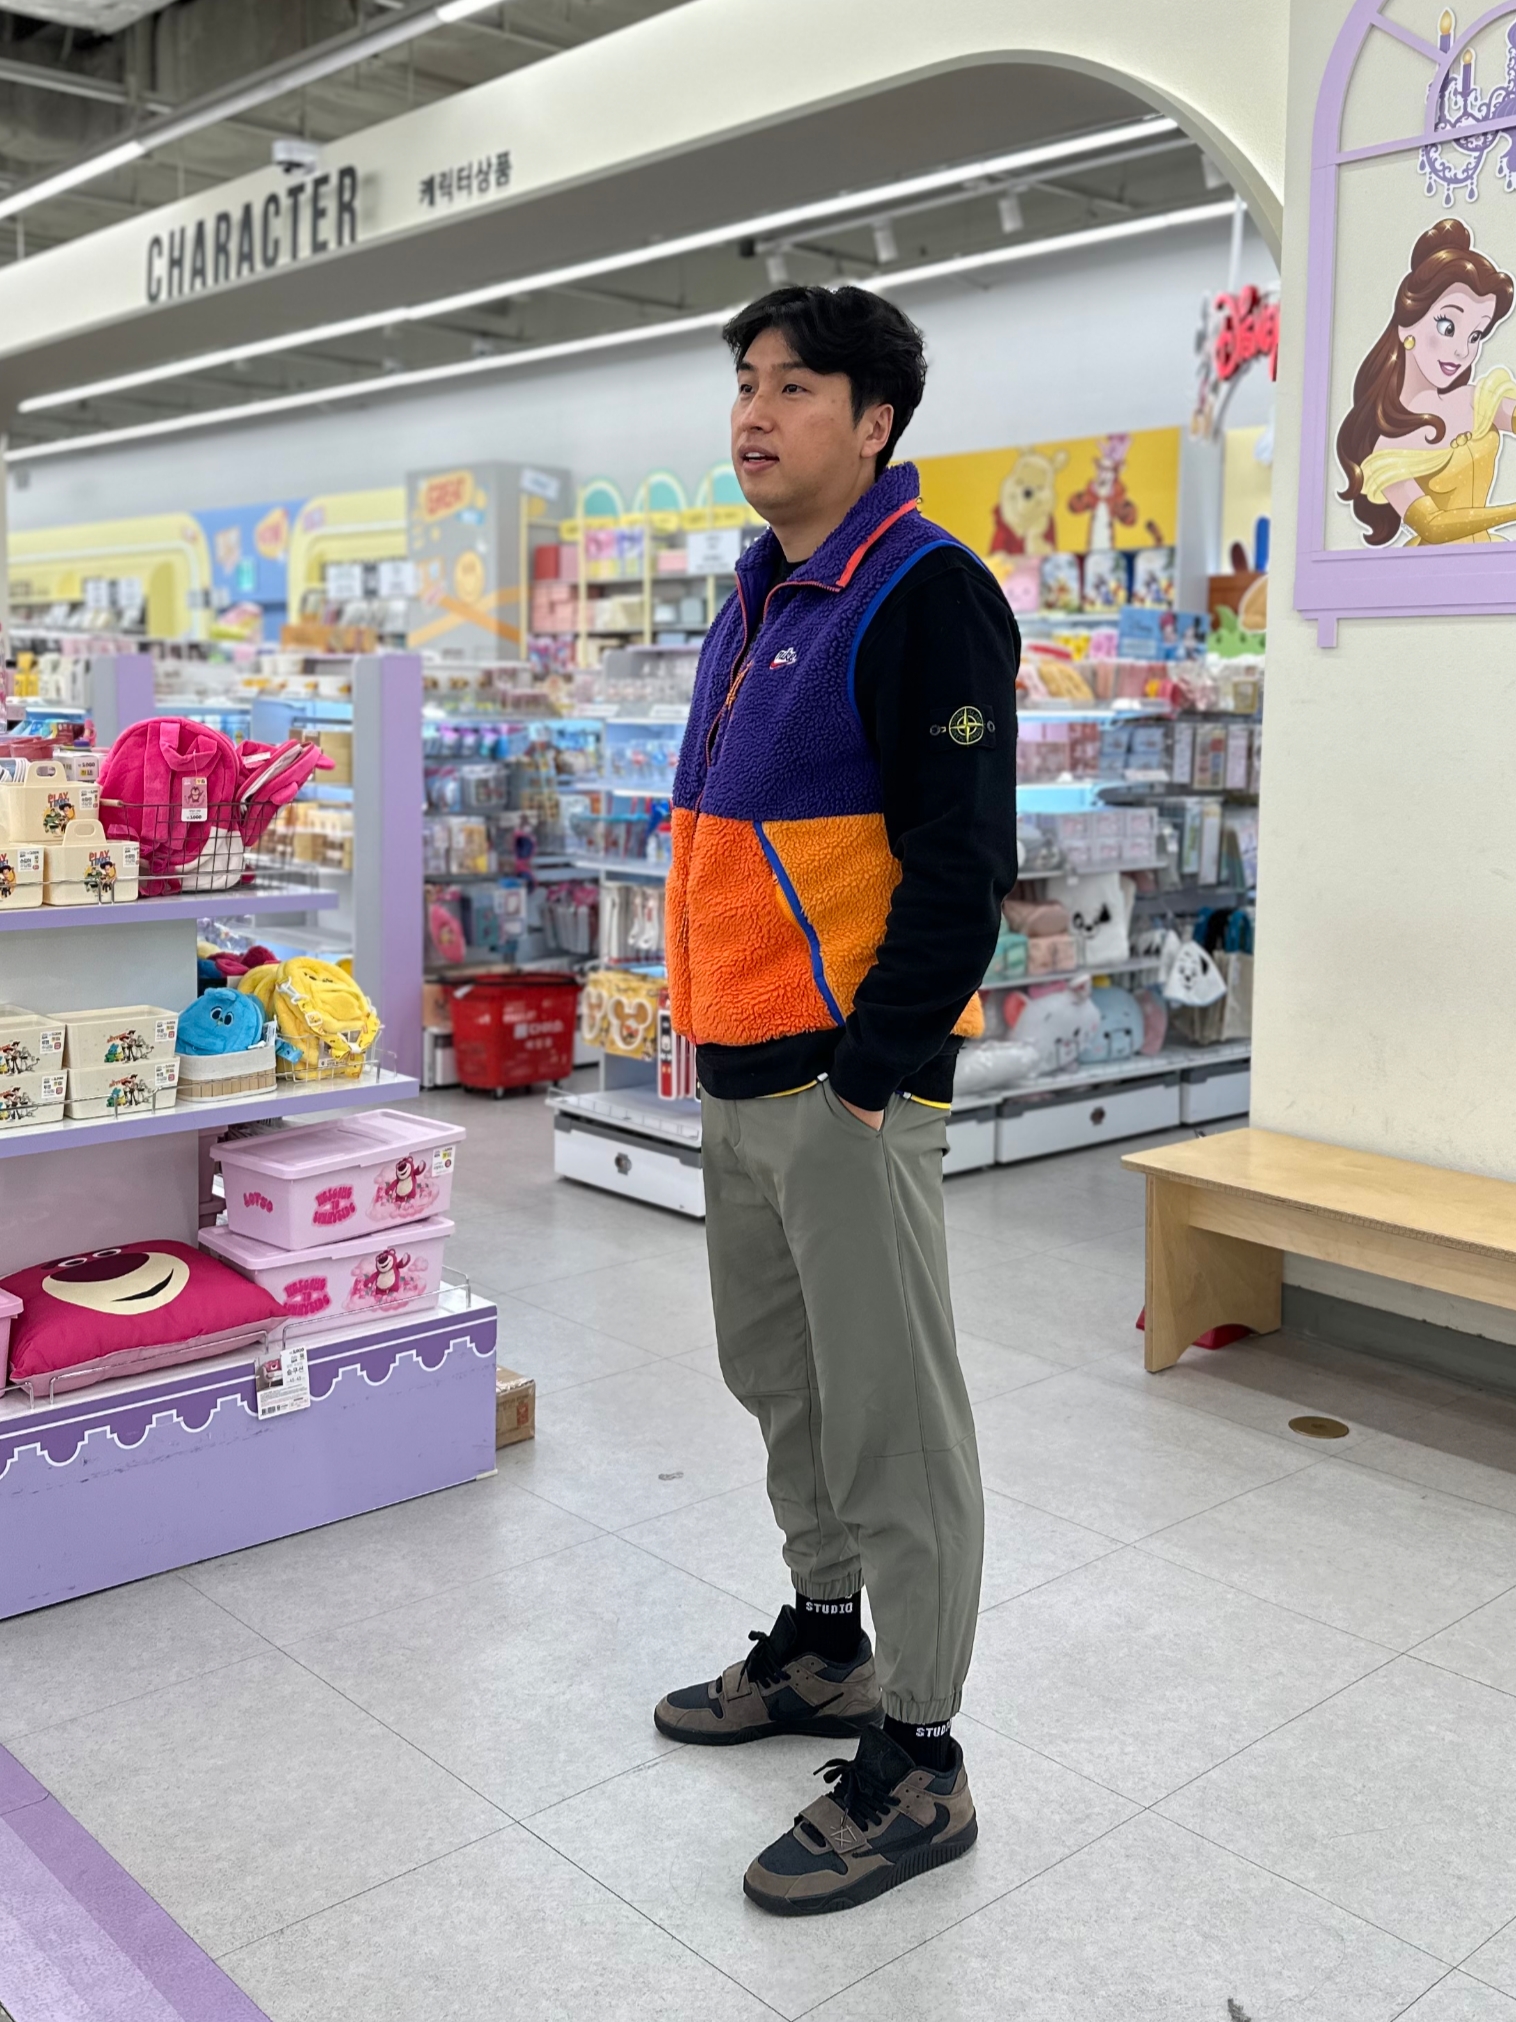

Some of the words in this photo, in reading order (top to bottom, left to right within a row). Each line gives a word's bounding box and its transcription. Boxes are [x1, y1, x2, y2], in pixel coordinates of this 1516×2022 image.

[419, 151, 512, 208] 캐릭터상품
[146, 165, 360, 304] CHARACTER
[47, 791, 69, 804] PLAY
[88, 849, 110, 862] PLAY
[243, 1192, 273, 1213] LOTSO
[805, 1601, 854, 1615] STUDIO
